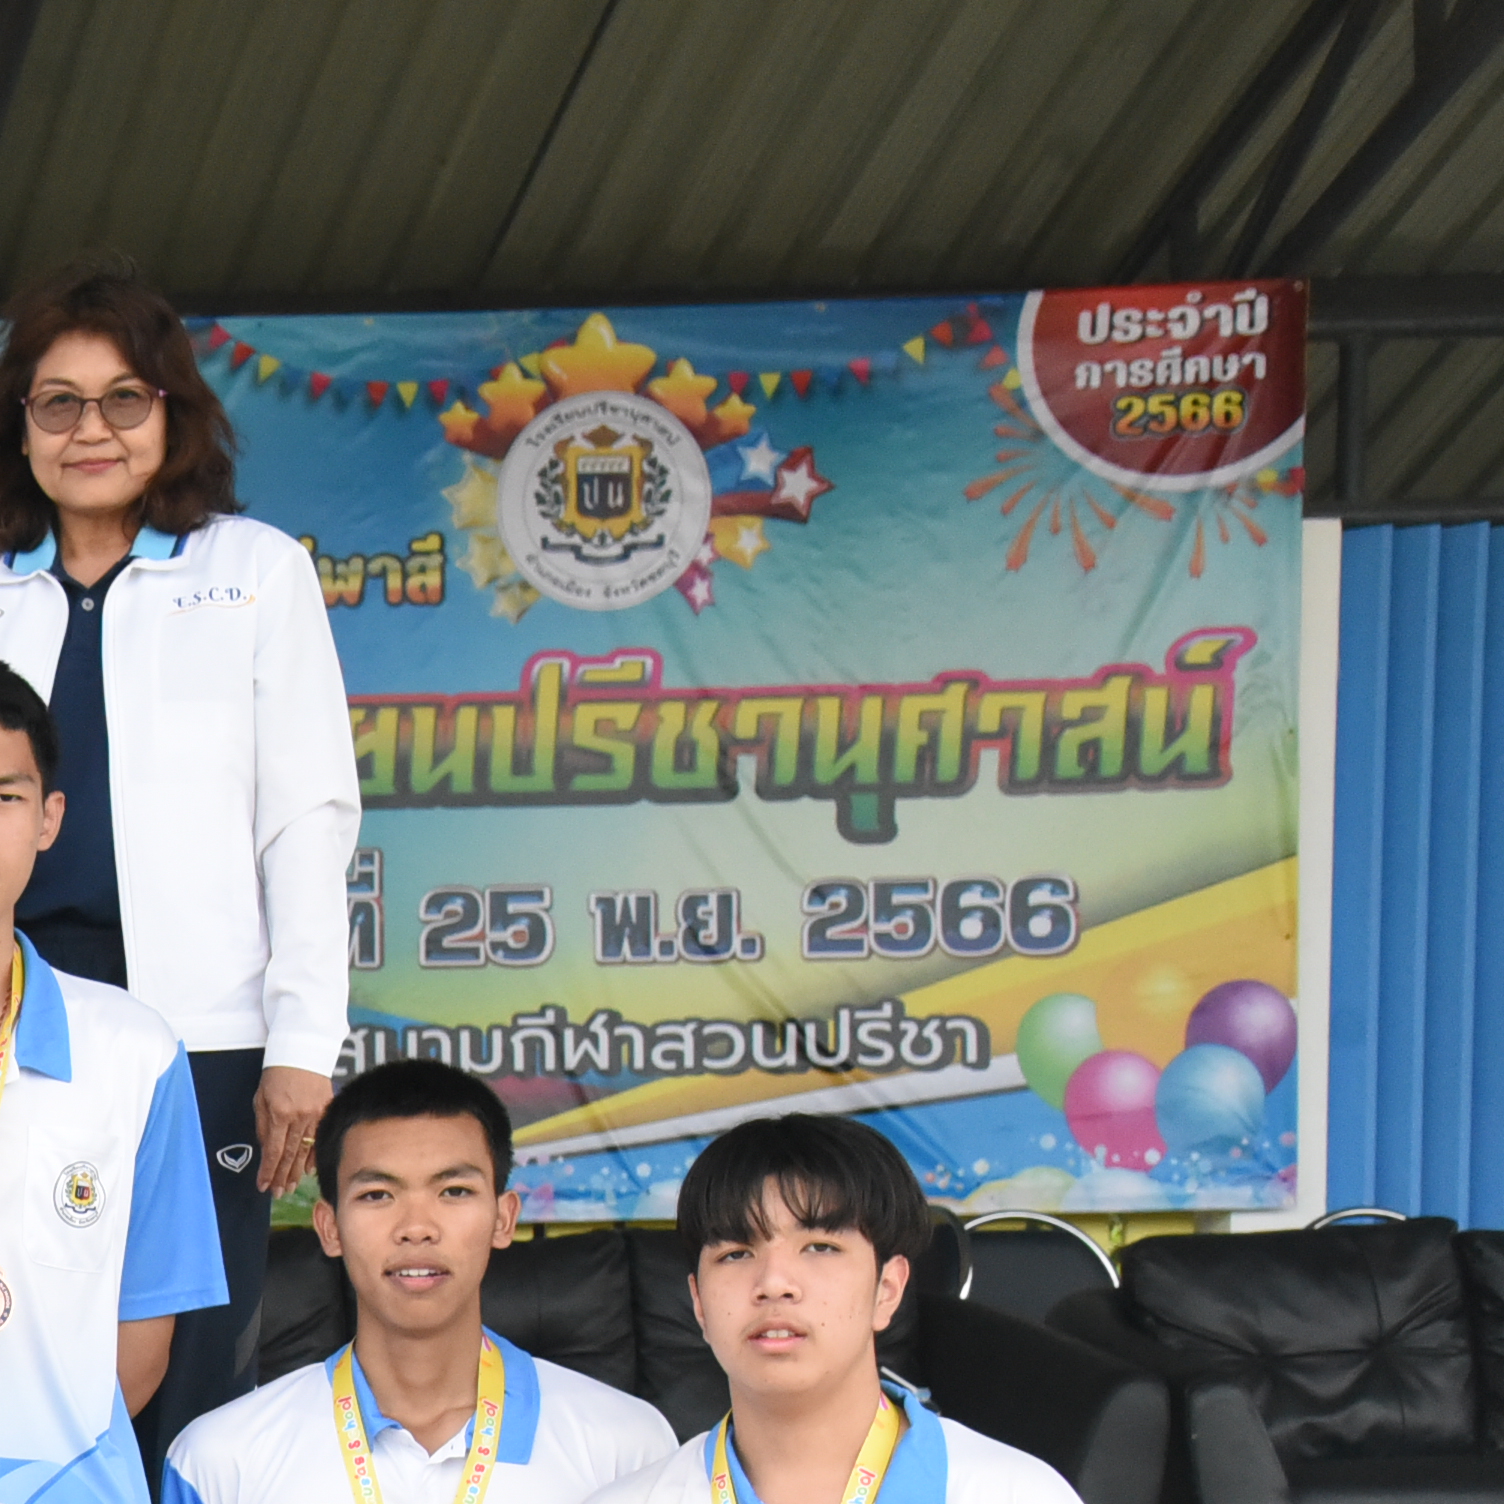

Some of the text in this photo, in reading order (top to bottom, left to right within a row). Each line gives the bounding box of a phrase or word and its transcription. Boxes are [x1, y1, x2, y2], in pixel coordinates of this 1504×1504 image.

[1076, 286, 1270, 345] ประจำปี
[1073, 346, 1267, 391] การศึกษา
[1113, 388, 1246, 438] 2566
[348, 630, 1248, 838] ยนปรีชานุศาสน์
[419, 886, 557, 968] 25
[591, 889, 762, 963] พ.ย.
[802, 874, 1079, 961] 2566
